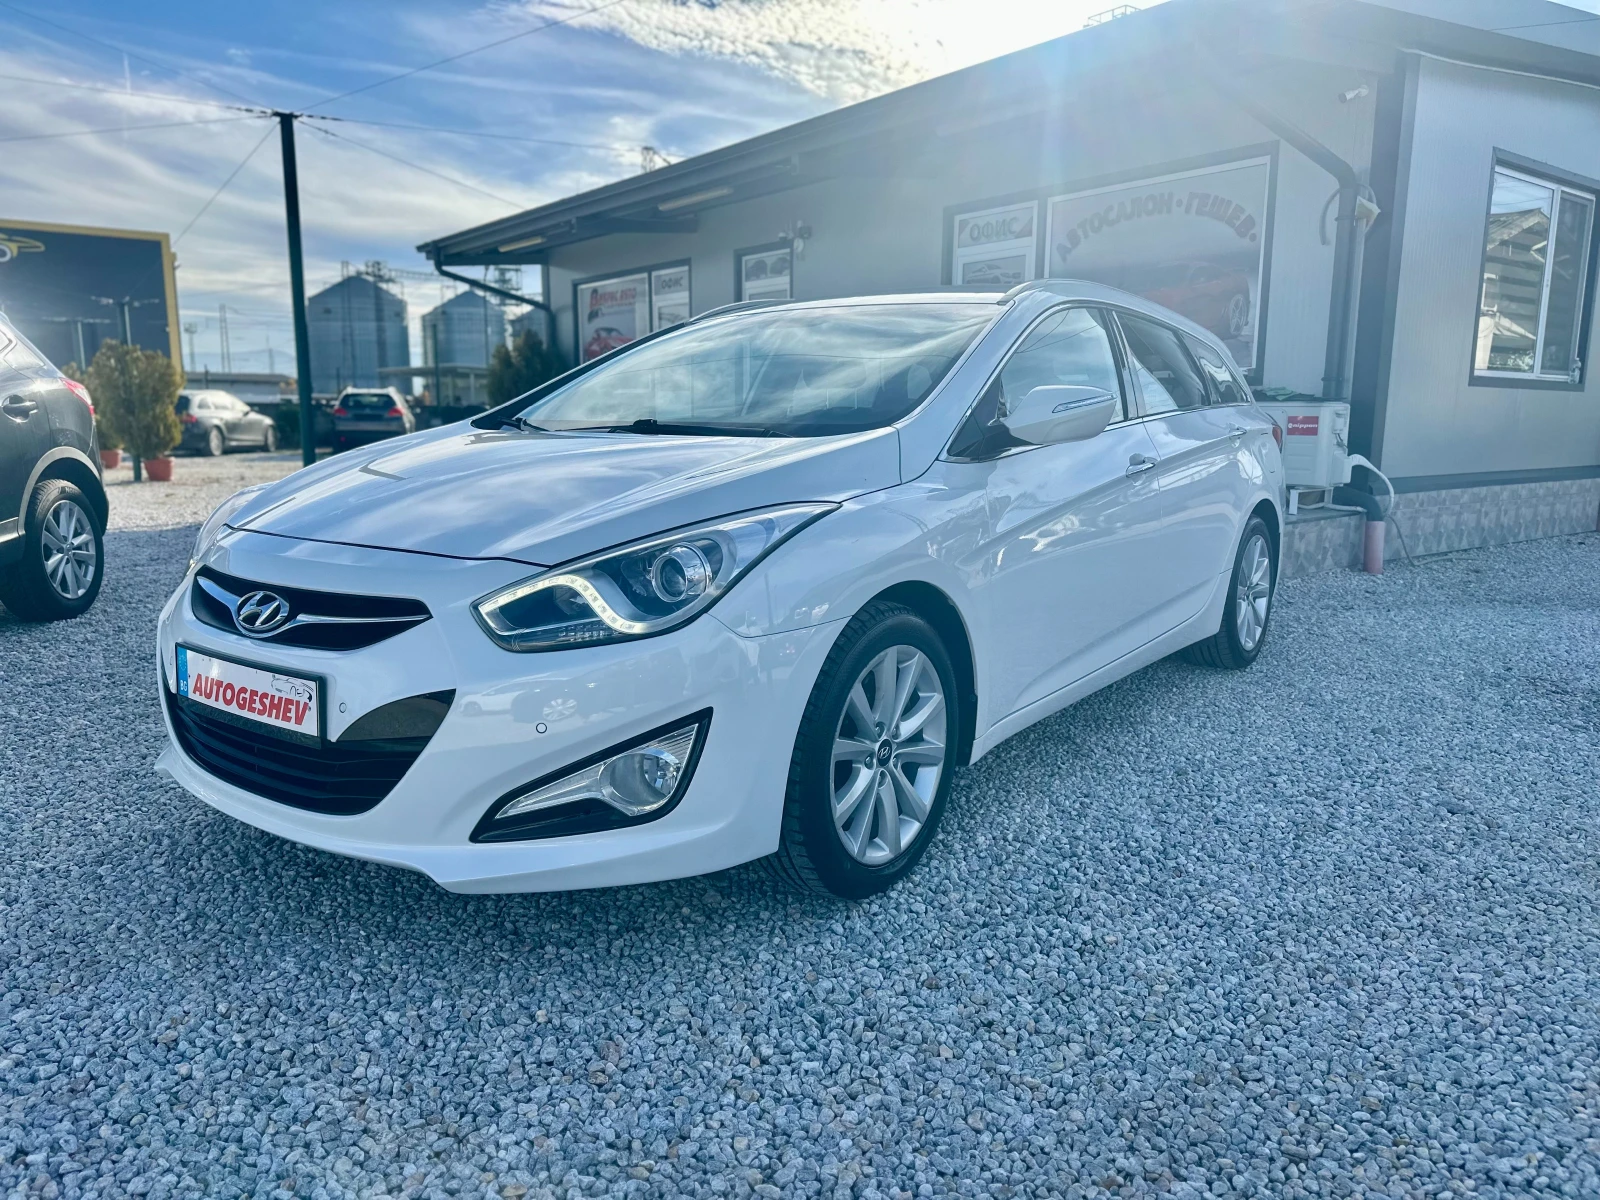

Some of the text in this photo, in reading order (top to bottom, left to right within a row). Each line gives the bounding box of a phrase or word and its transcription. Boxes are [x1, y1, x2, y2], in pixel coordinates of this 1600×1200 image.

[969, 216, 1019, 242] ОФИС
[1056, 191, 1256, 264] АВТОСАЛОН ГЕШЕВ
[180, 680, 187, 691] BG
[192, 673, 309, 726] AUTOGESHEV
